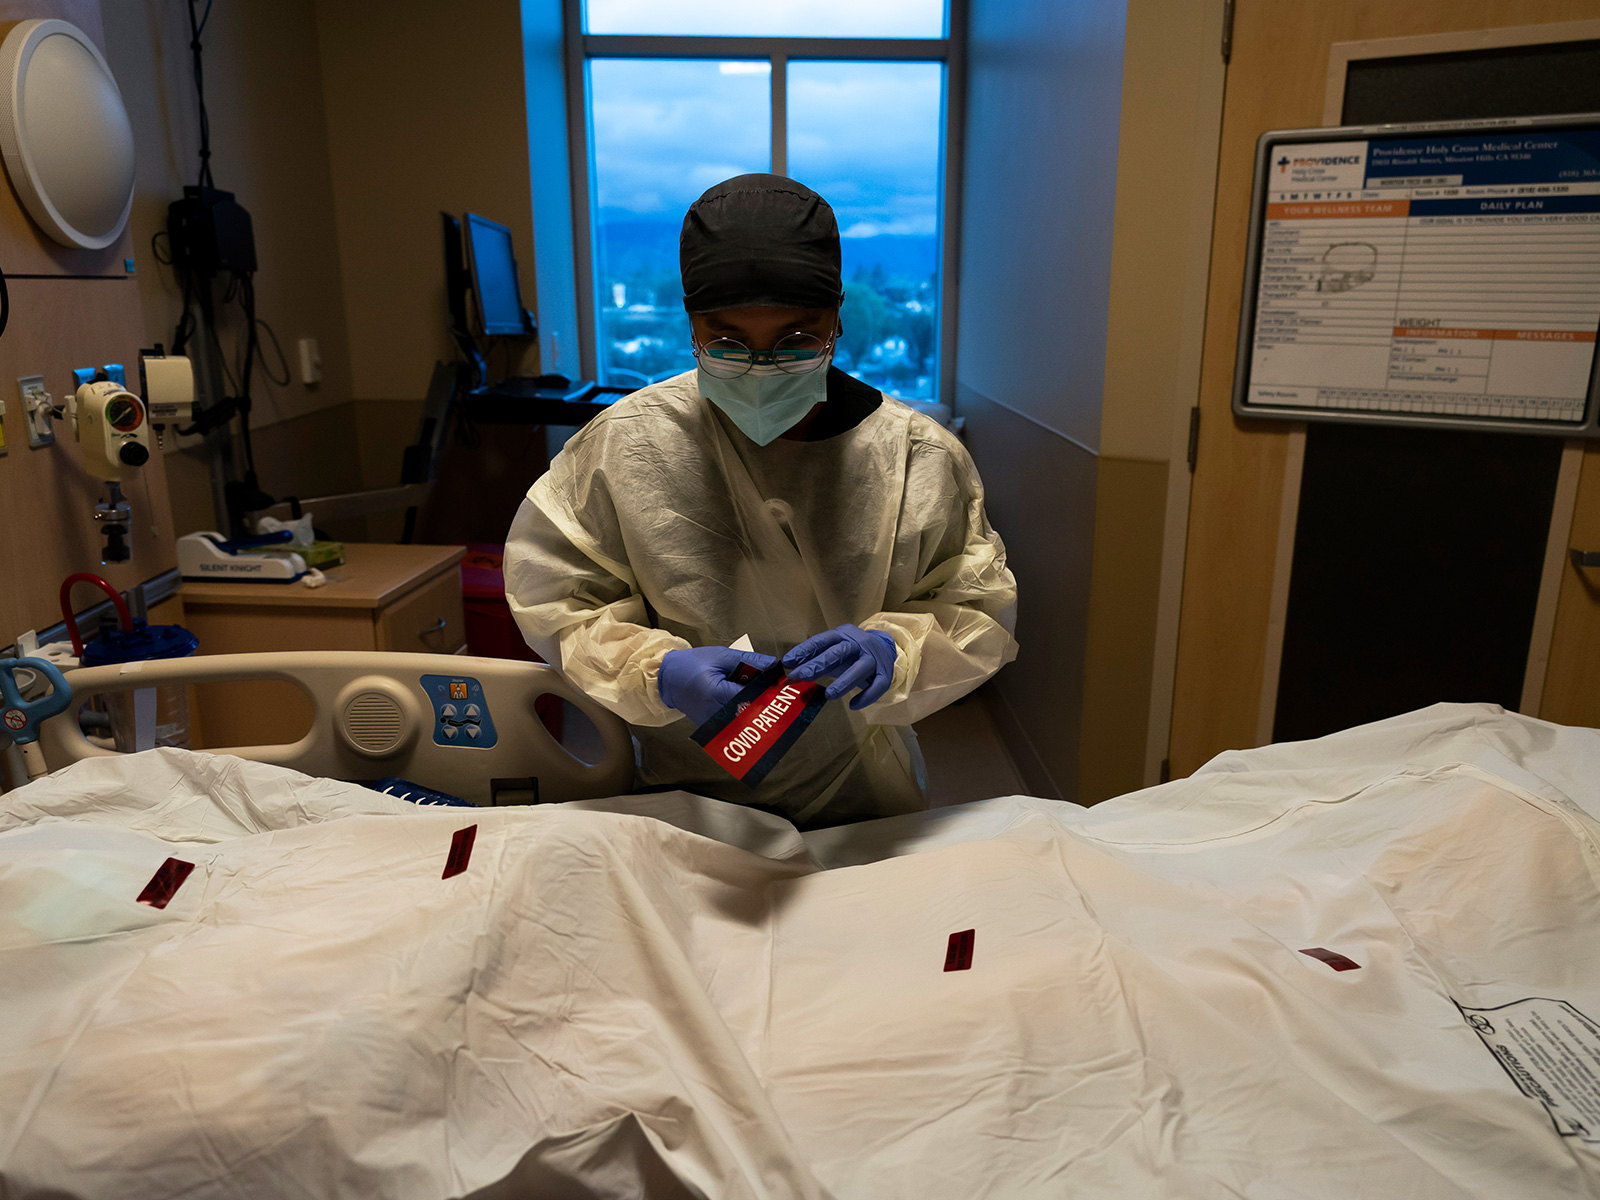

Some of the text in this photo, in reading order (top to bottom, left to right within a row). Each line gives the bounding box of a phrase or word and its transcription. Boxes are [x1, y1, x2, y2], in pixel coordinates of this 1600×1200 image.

[1373, 141, 1558, 157] Providence Holy Cross Medical Center
[1292, 156, 1360, 166] PROVIDENCE
[1284, 204, 1393, 215] YOUR WELLNESS TEAM
[1480, 201, 1544, 210] DAILY PLAN
[1399, 318, 1441, 327] WEIGHT
[1406, 328, 1478, 338] INFORMATION
[1516, 331, 1574, 340] MESSAGES
[200, 564, 262, 572] SILENT KNIGHT
[723, 684, 801, 763] COVID PATIENT
[1496, 1044, 1559, 1108] PRECAUTIONS
